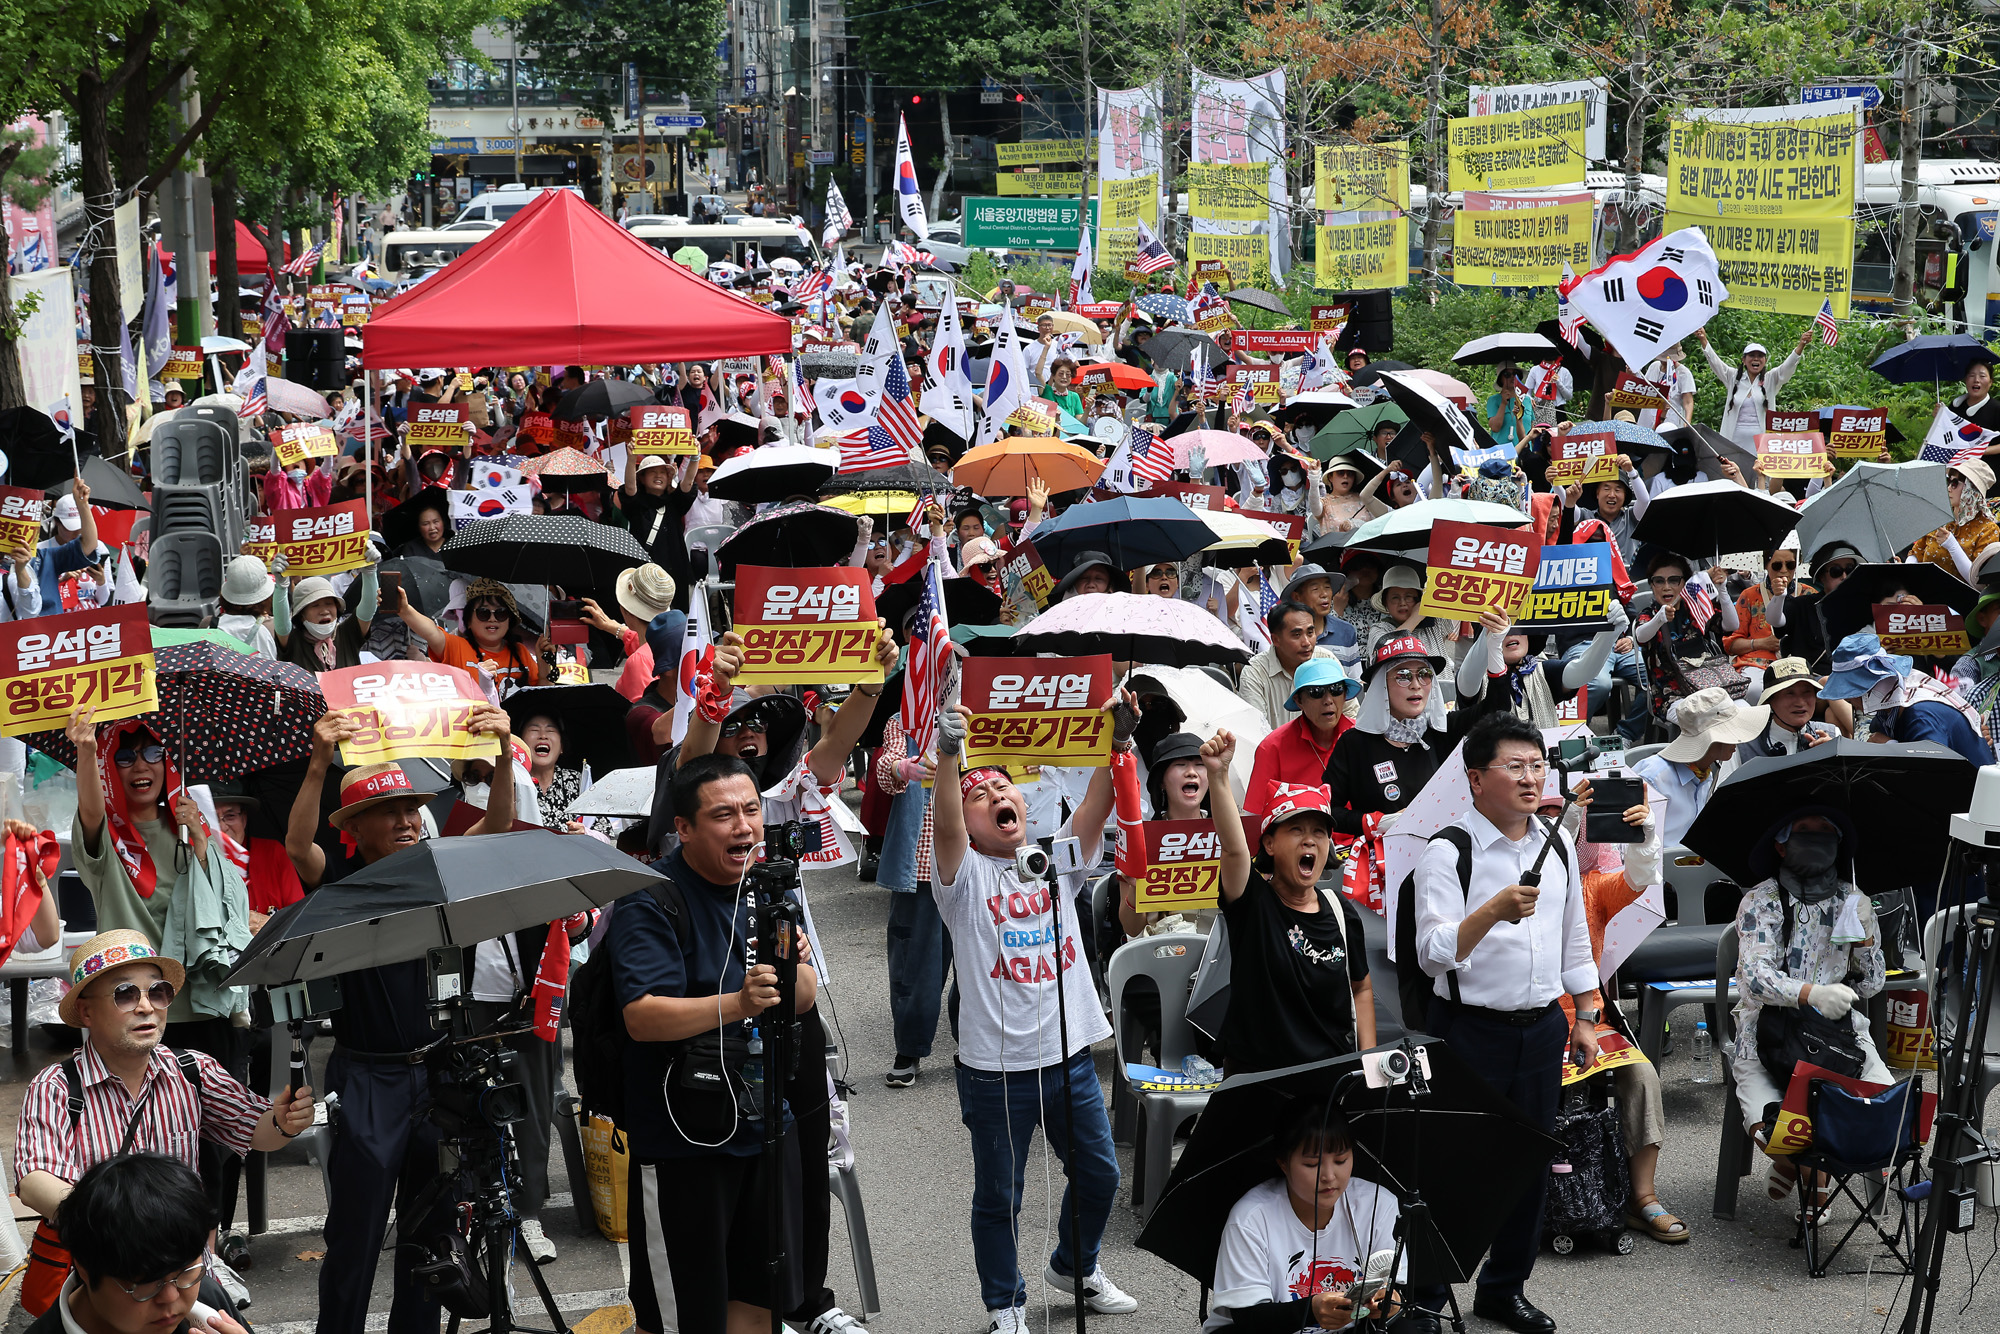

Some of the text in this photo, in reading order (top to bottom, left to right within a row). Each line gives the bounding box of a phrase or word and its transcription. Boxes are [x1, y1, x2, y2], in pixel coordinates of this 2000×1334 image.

[1451, 124, 1488, 146] 서울고등법원
[1490, 121, 1520, 144] 형사7부는
[1522, 117, 1542, 139] 대법원
[1705, 131, 1746, 162] 이재명의
[1750, 129, 1771, 161] 국회
[1522, 147, 1536, 168] 신속
[1680, 164, 1840, 200] 헌법 재판소 장악 시도 규탄한다!
[973, 207, 1058, 222] 서울중앙지방법원
[1474, 213, 1568, 240] 독재자 이재명은 자기 살기 위해
[1008, 237, 1030, 245] 140m
[1353, 227, 1364, 250] 재판
[1718, 226, 1752, 252] 이재명은
[1755, 228, 1774, 253] 자기
[1777, 229, 1795, 254] 살기
[1799, 229, 1819, 255] 위해
[1493, 246, 1526, 268] 헌법재판관
[1527, 245, 1541, 267] 먼저
[1542, 243, 1572, 266] 임명하는
[1201, 262, 1220, 271] 윤석열
[1719, 259, 1758, 286] 법재판관
[1760, 262, 1779, 288] 먼저
[1782, 263, 1821, 292] 임명하는
[1030, 298, 1052, 308] 윤석열
[1200, 306, 1225, 320] 윤석열
[1317, 307, 1344, 319] 윤석열
[1198, 315, 1230, 330] 영장기각
[1252, 335, 1277, 344] YOON,
[1279, 336, 1306, 344] AGAIN
[1082, 373, 1106, 386] 윤석열
[1235, 369, 1271, 383] 윤석열
[1622, 380, 1660, 397] 윤석열
[1614, 392, 1663, 407] 영장기각
[417, 408, 459, 423] 윤석열
[642, 411, 685, 428] 윤석열
[1772, 416, 1809, 432] 윤석열
[1841, 415, 1882, 432] 윤석열
[280, 425, 323, 443] 윤석열
[410, 424, 464, 438] 영장기각
[636, 431, 693, 446] 영장기각
[1562, 440, 1605, 459] 윤석열
[1767, 438, 1813, 454] 윤석열
[1832, 433, 1886, 449] 영장기각
[1763, 456, 1823, 471] 영장기각
[291, 511, 355, 540] 윤석열
[284, 536, 365, 566] 영장기각
[1450, 536, 1528, 575] 윤석열
[1432, 571, 1529, 611] 영장기각
[762, 583, 860, 621] 윤석열
[1888, 613, 1947, 633] 윤석열
[16, 622, 122, 672] 윤석열
[742, 628, 876, 666] 영장기각
[1382, 637, 1414, 656] 이재명
[1880, 634, 1962, 649] 영장기각
[5, 662, 143, 715] 영장기각
[352, 672, 459, 703] 윤석열
[988, 673, 1093, 710] 윤석열
[968, 715, 1105, 749] 영장기각
[366, 767, 407, 792] 이재명
[802, 847, 842, 863] AGAIN
